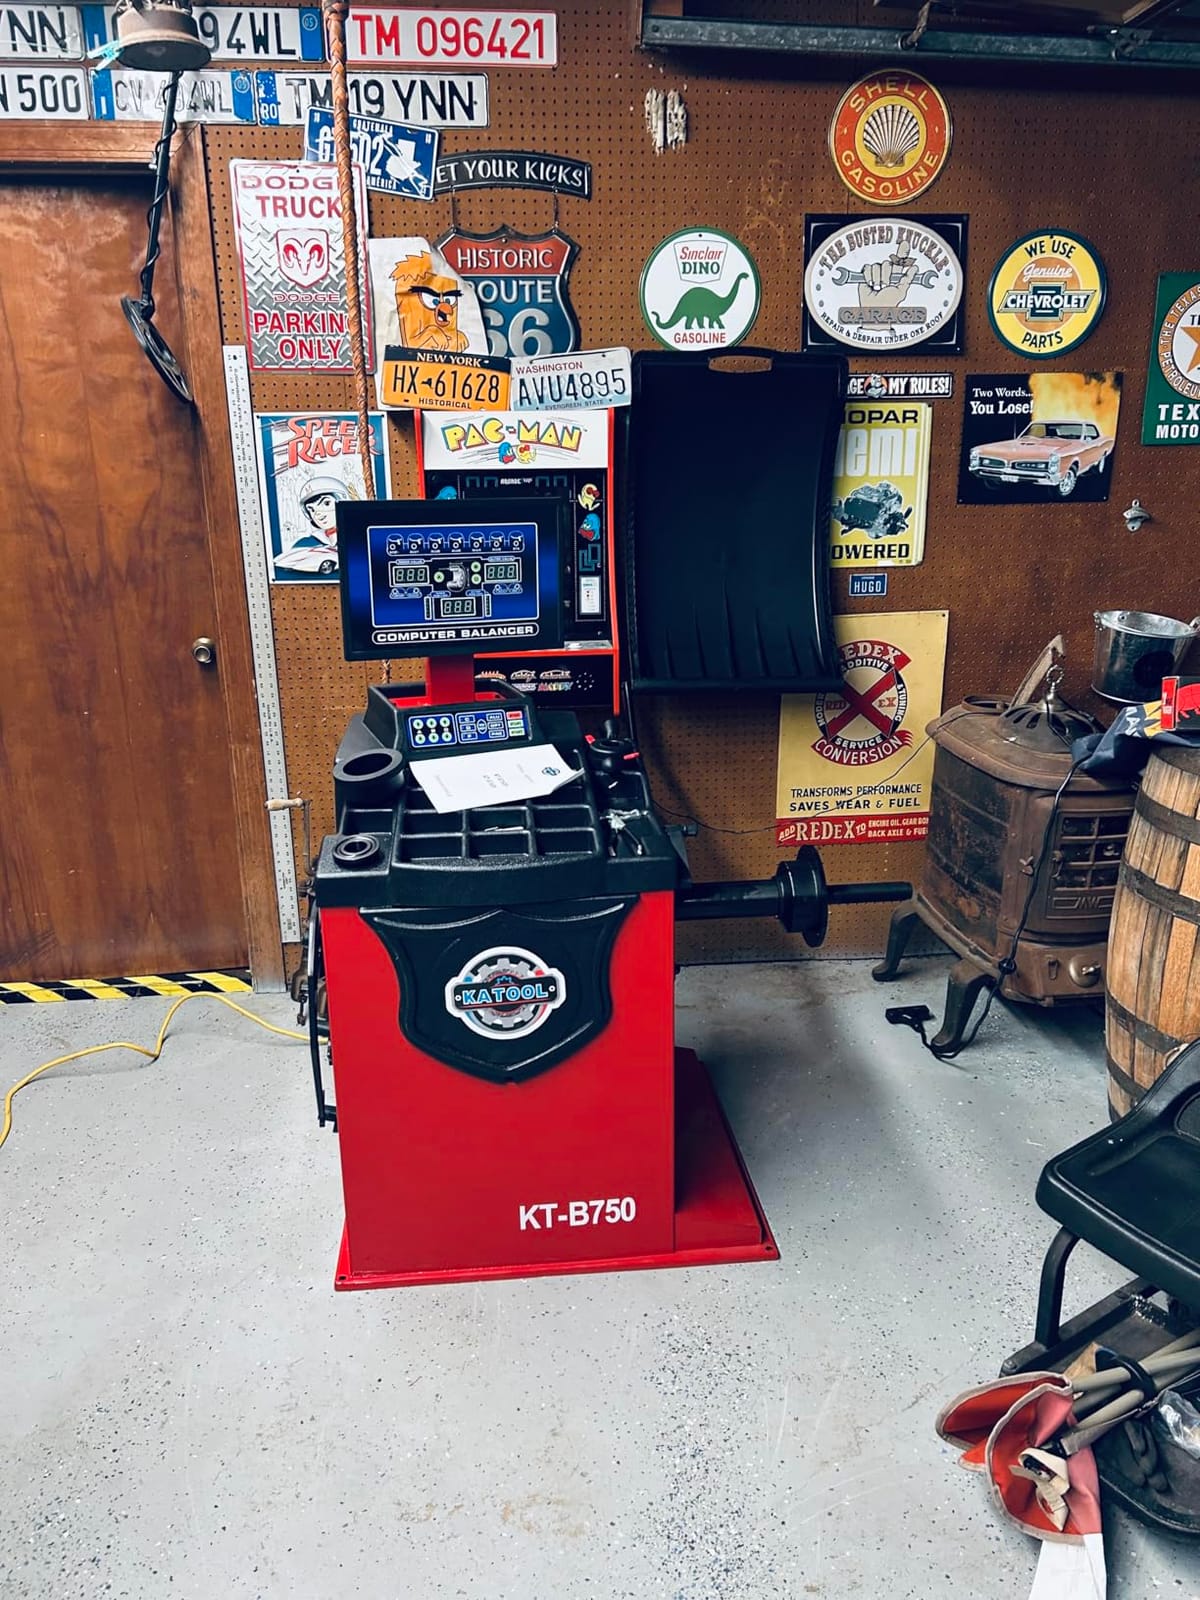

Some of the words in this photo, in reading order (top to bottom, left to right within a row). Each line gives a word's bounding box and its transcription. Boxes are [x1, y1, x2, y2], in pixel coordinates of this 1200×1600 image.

[0, 9, 67, 52] NN
[352, 14, 400, 56] TM
[416, 16, 545, 59] 096421
[17, 74, 82, 113] 500
[392, 79, 474, 121] YNN
[849, 77, 929, 112] SHELL
[260, 103, 277, 119] RO
[435, 162, 458, 183] ET
[463, 159, 520, 179] YOUR
[525, 160, 583, 187] KICKS
[841, 150, 938, 196] GASOLINE
[241, 176, 340, 190] DODG
[256, 195, 343, 218] TRUCK
[680, 246, 723, 260] Sinclair
[819, 239, 847, 271] THE
[846, 225, 893, 252] BUSTED
[896, 226, 950, 273] KNUCKLE
[1024, 240, 1046, 258] WE
[1051, 239, 1077, 259] USE
[457, 248, 553, 269] HISTORIC
[681, 262, 720, 275] DINO
[1023, 263, 1073, 282] Genuine
[273, 292, 340, 303] DODGE
[1006, 294, 1087, 308] CHEVROLET
[254, 312, 350, 334] PARKIN
[839, 309, 926, 324] GARAGE
[820, 311, 844, 334] REPAIR
[852, 332, 882, 344] DESPAIR
[884, 333, 909, 344] UNDER
[910, 326, 925, 339] ONE
[1160, 321, 1175, 345] THE
[674, 332, 726, 344] GASOLINE
[1021, 330, 1064, 348] PARTS
[278, 338, 343, 361] ONLY
[416, 352, 448, 364] NEW
[450, 354, 482, 367] YORK
[516, 361, 583, 374] WASHINGTON
[518, 368, 626, 407] AVU4895
[847, 378, 865, 394] GE
[888, 377, 908, 395] MY
[909, 377, 950, 394] RULES!
[972, 387, 993, 398] Two
[995, 387, 1033, 398] Words...
[418, 397, 472, 410] HISTORICAL
[970, 401, 994, 414] You
[998, 400, 1034, 414] Lose!
[847, 409, 918, 424] OPAR
[441, 417, 582, 452] PAC-MAN
[831, 543, 910, 560] OWERED
[854, 581, 882, 593] HUGO
[376, 629, 456, 642] COMPUTER
[461, 625, 534, 638] BALANCER
[842, 641, 901, 664] EDEX
[815, 735, 903, 765] CONVERSION
[835, 735, 882, 750] SERVICE
[790, 786, 853, 799] TRANSFORMS
[856, 783, 922, 796] PERFORMANCE
[789, 801, 829, 812] SAVES
[835, 799, 871, 810] WEAR
[875, 799, 884, 809] &
[888, 797, 921, 808] FUEL
[778, 825, 796, 840] ADD
[855, 822, 867, 834] TO
[868, 829, 886, 838] BACK
[886, 828, 904, 837] AXLE
[462, 983, 548, 1005] KATOOL
[519, 1196, 636, 1230] KT-B750
